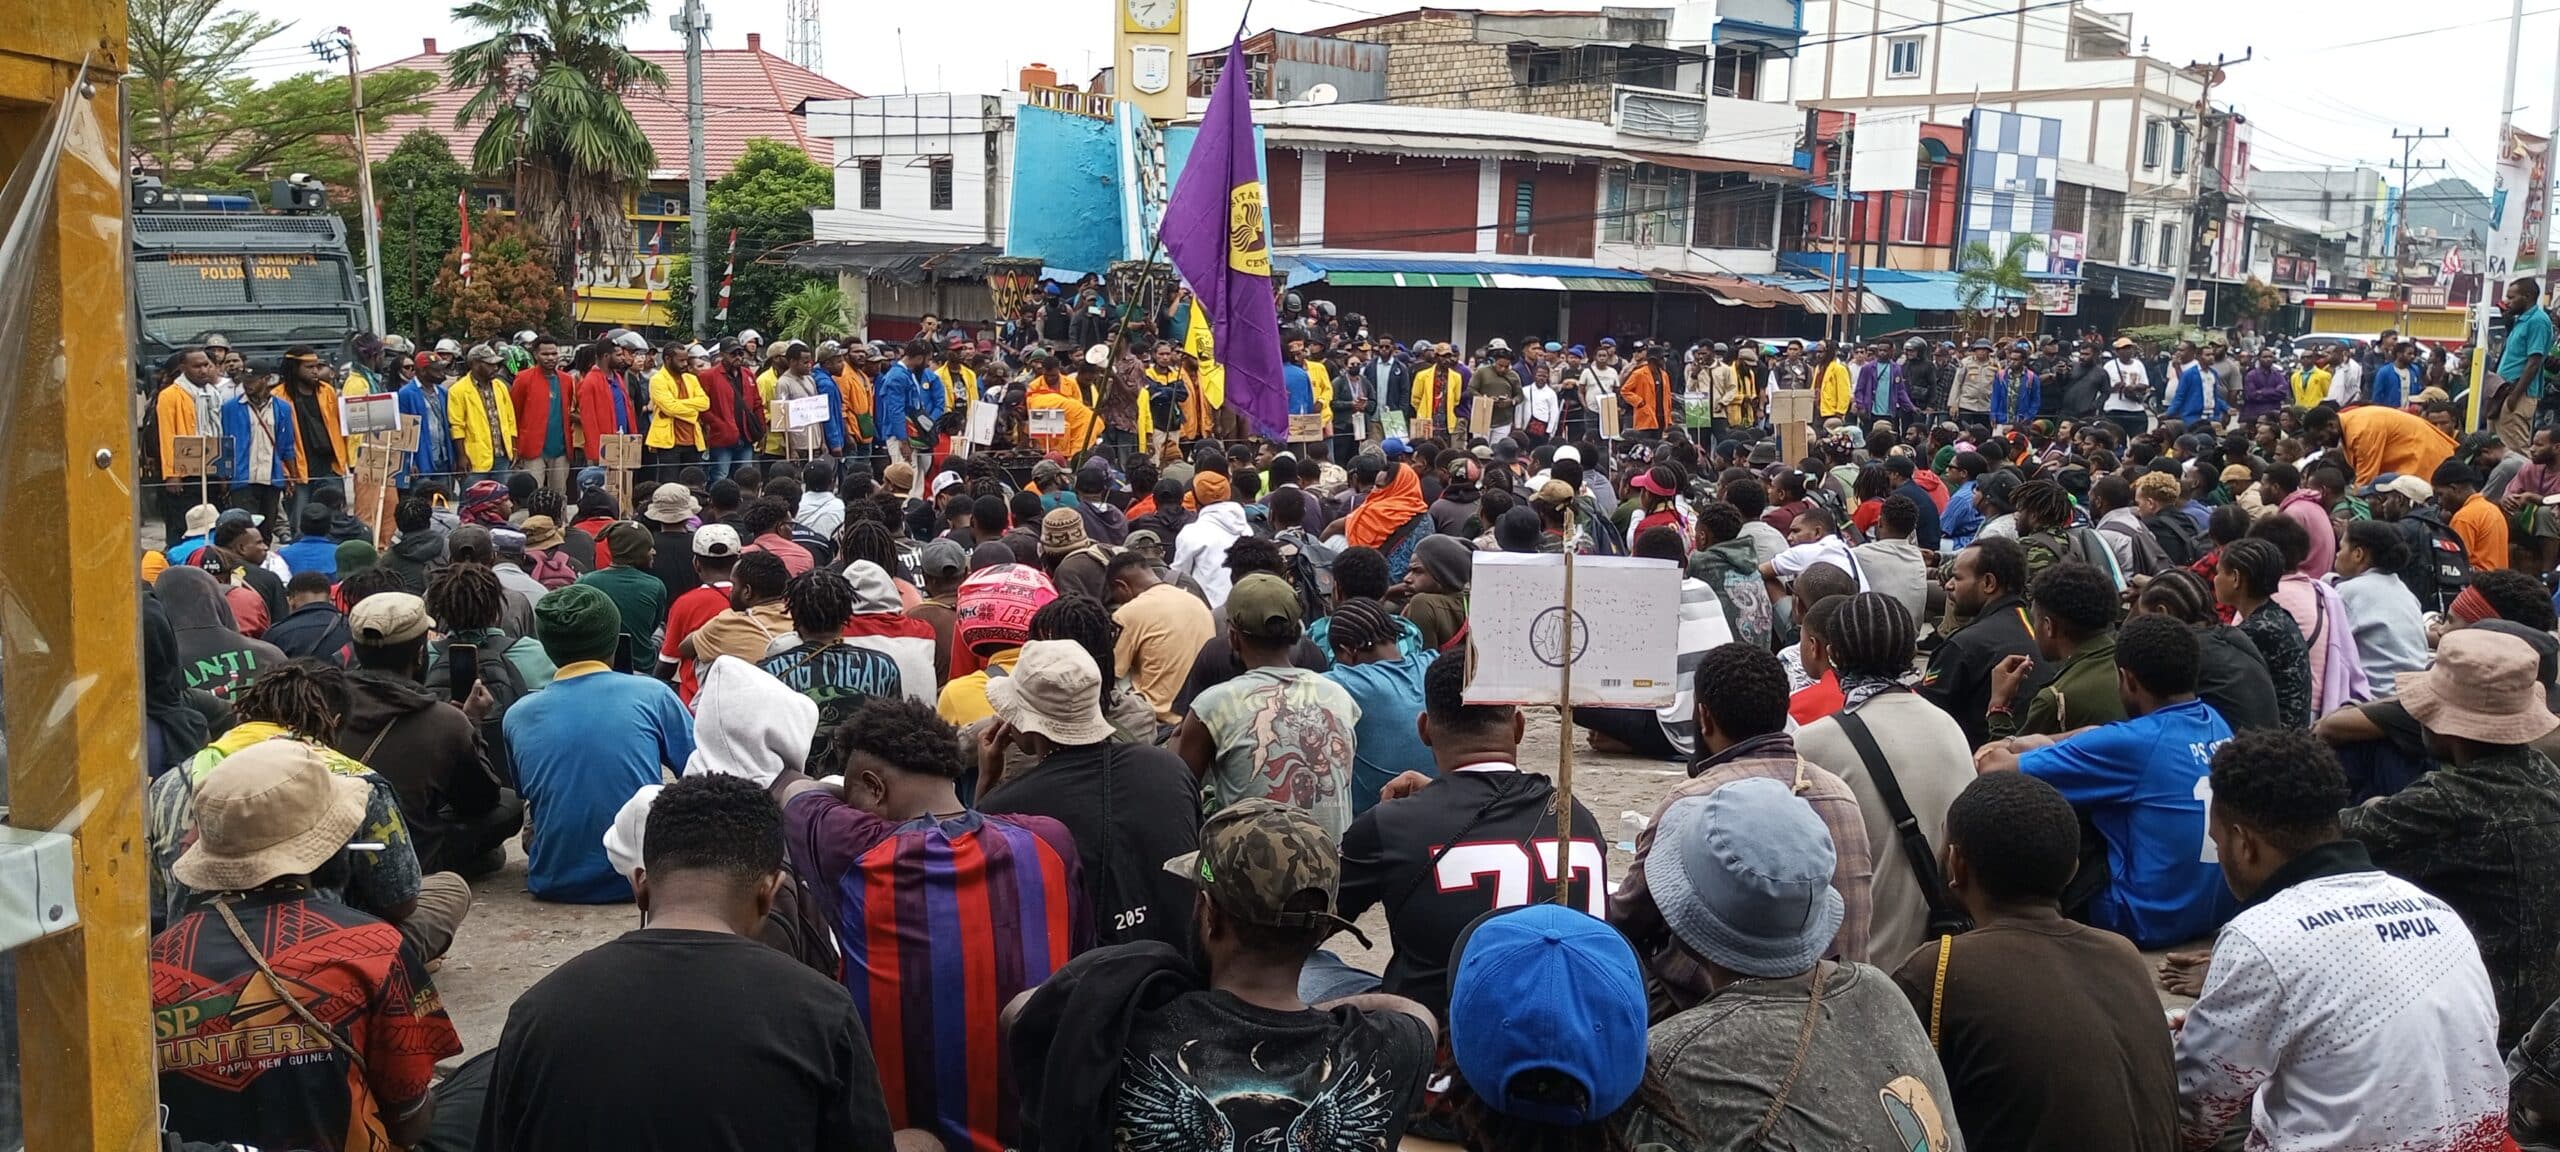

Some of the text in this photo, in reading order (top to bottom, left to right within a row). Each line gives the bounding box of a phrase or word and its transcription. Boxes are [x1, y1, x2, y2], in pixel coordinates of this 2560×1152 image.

[200, 266, 246, 280] POLDA
[2441, 564, 2461, 577] FILA
[2297, 908, 2345, 932] IAIN
[2342, 898, 2423, 921] FATTAHUL
[2374, 916, 2441, 943] PAPUA
[156, 1005, 200, 1040] SP
[218, 1052, 334, 1076] PAPUA NEW GUINEA
